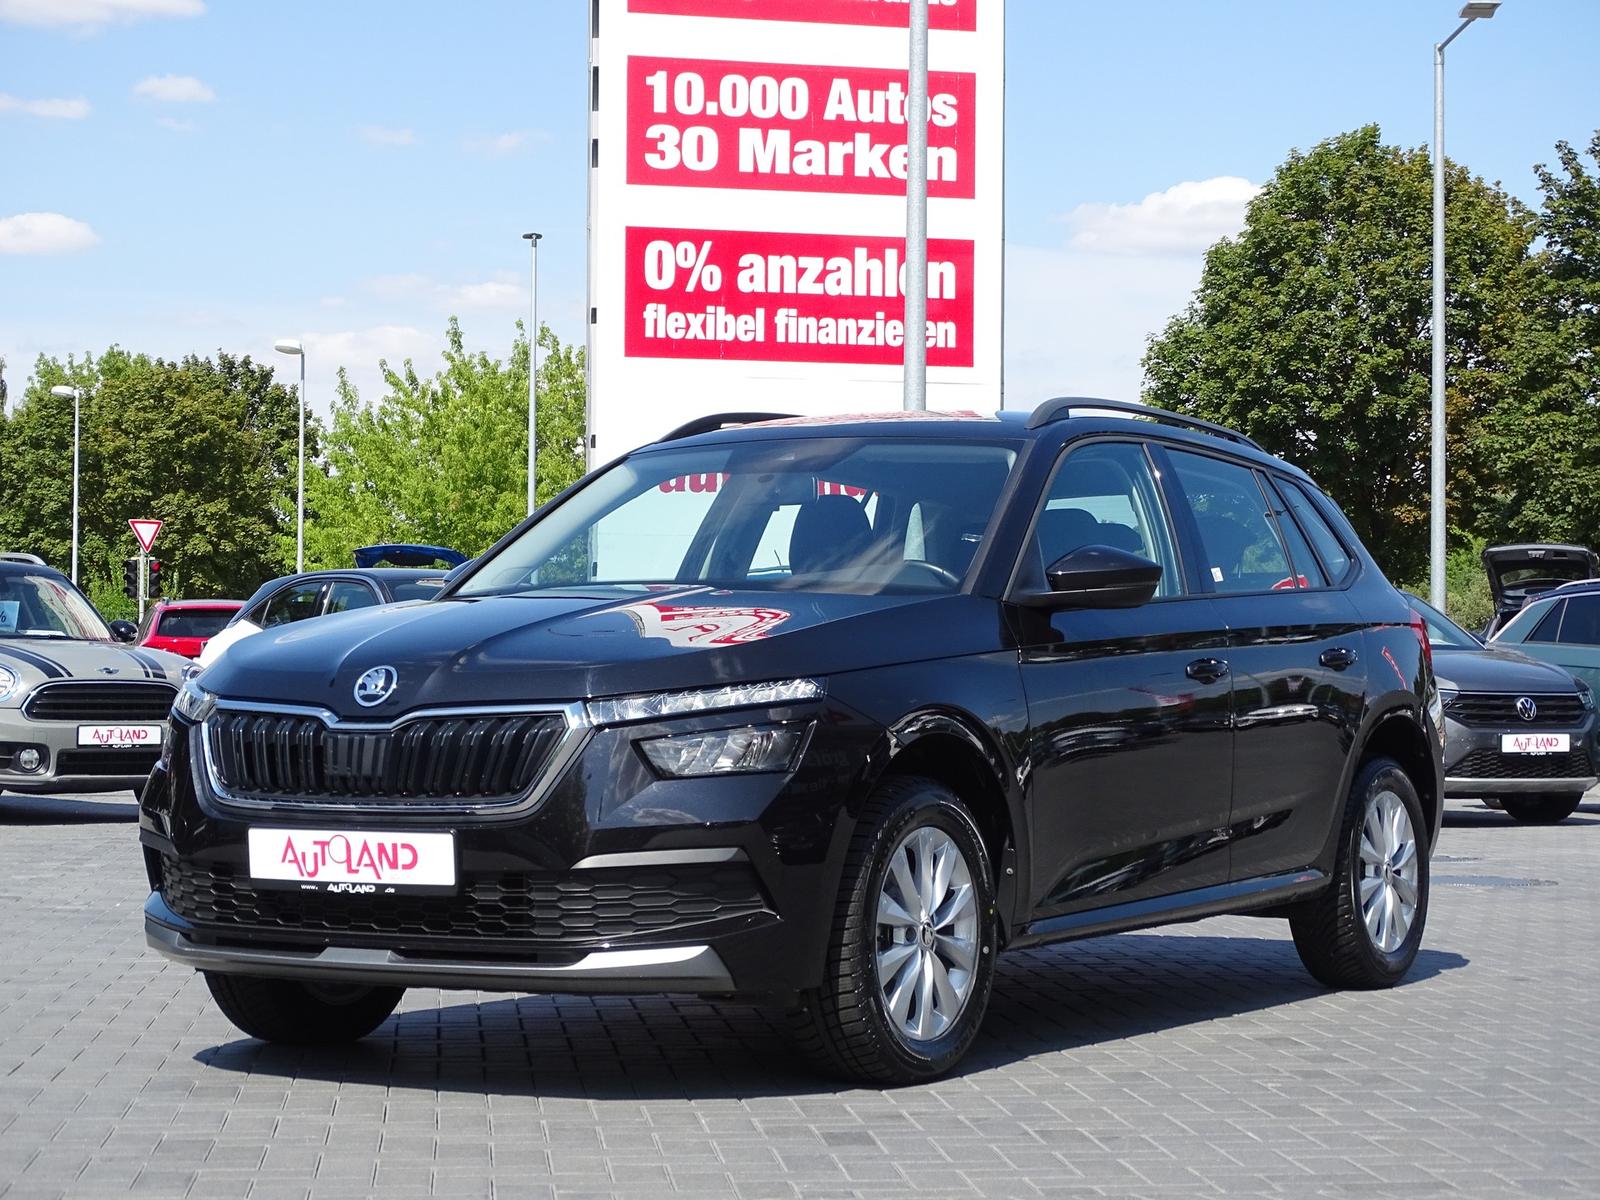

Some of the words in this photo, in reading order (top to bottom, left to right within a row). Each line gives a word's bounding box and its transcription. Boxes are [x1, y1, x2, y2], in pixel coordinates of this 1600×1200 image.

[645, 70, 809, 120] 10.000
[644, 124, 719, 171] 30
[738, 128, 957, 182] Marken
[644, 240, 722, 293] 0%
[737, 248, 956, 300] anzahln
[643, 303, 765, 342] flexibel
[774, 311, 956, 349] finanzieen
[281, 834, 418, 880] AUTOLAND
